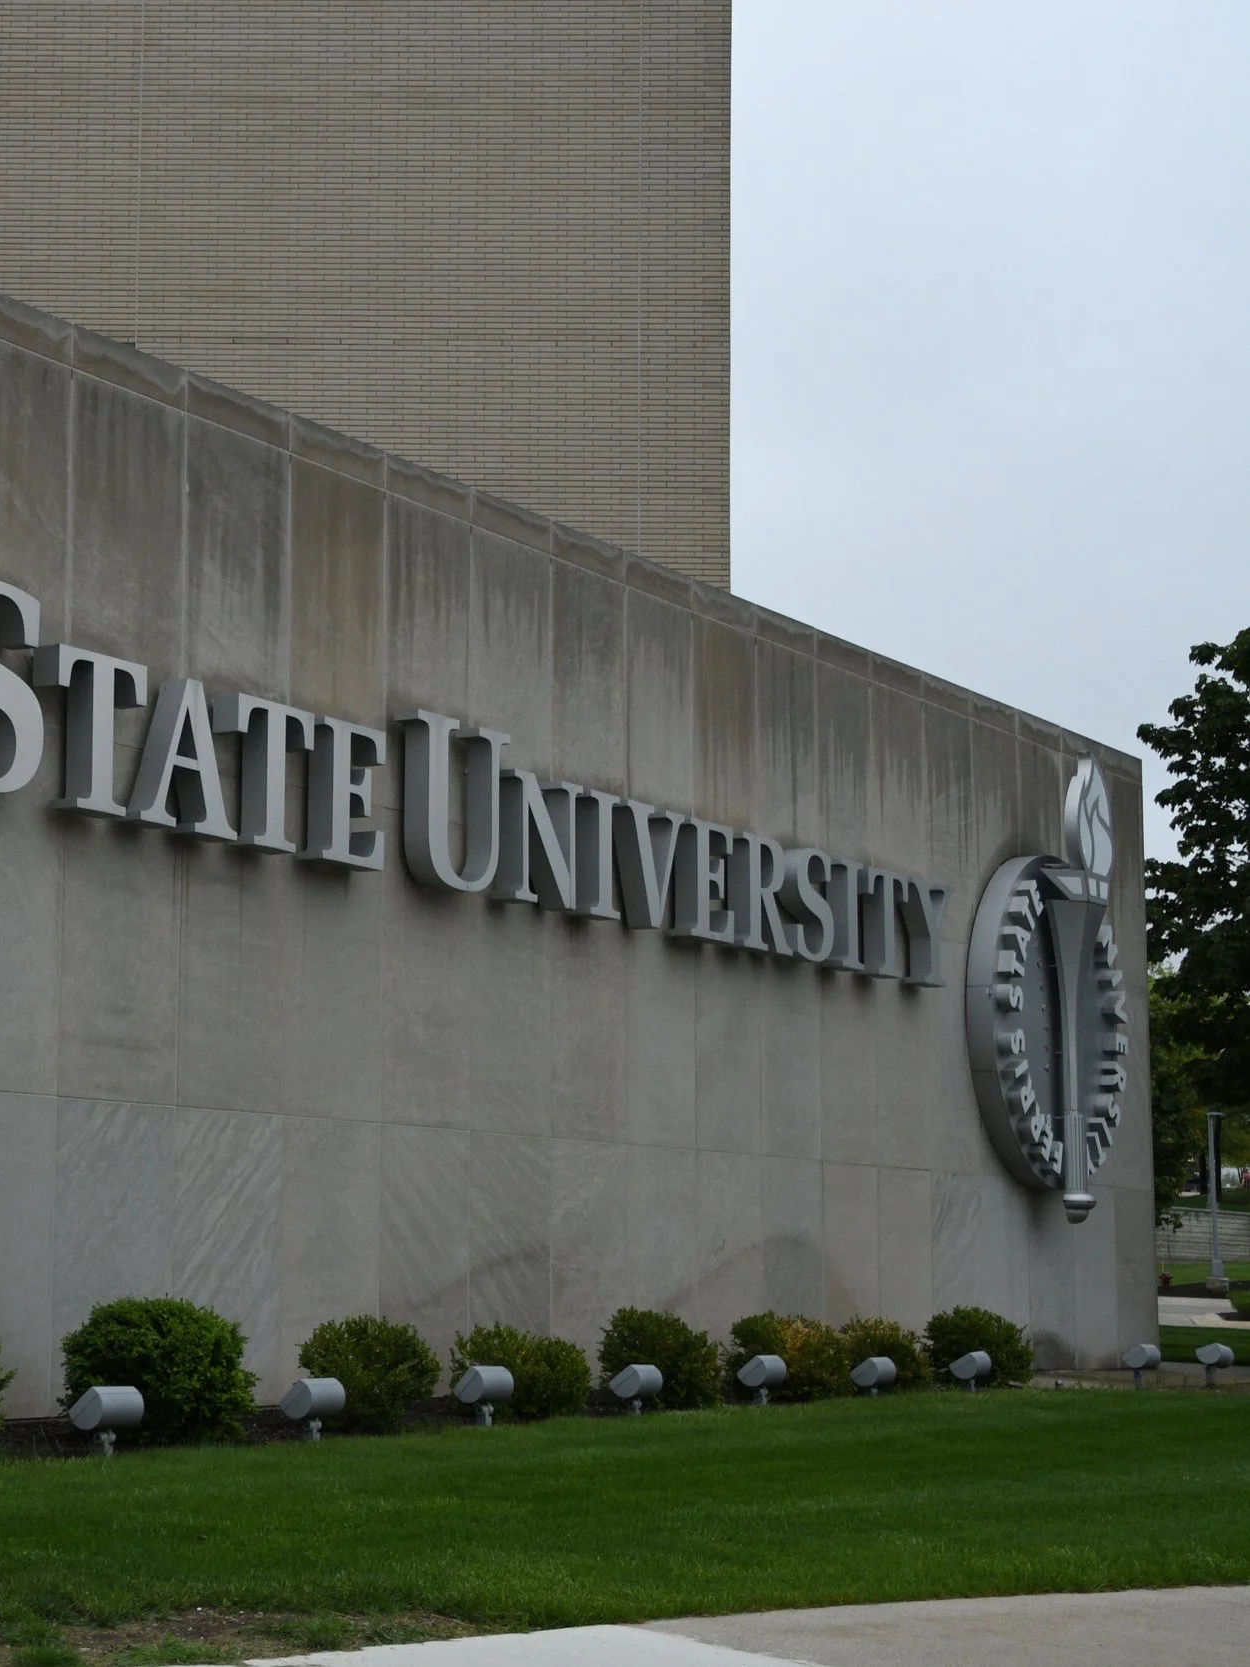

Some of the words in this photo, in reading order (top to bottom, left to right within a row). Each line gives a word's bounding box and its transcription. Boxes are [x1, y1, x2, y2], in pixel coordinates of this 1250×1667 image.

[395, 708, 950, 988] UNIVERSITY
[997, 879, 1045, 1013] STATE
[998, 1029, 1064, 1175] FERRIS
[1086, 924, 1129, 1177] NIVERSIT
